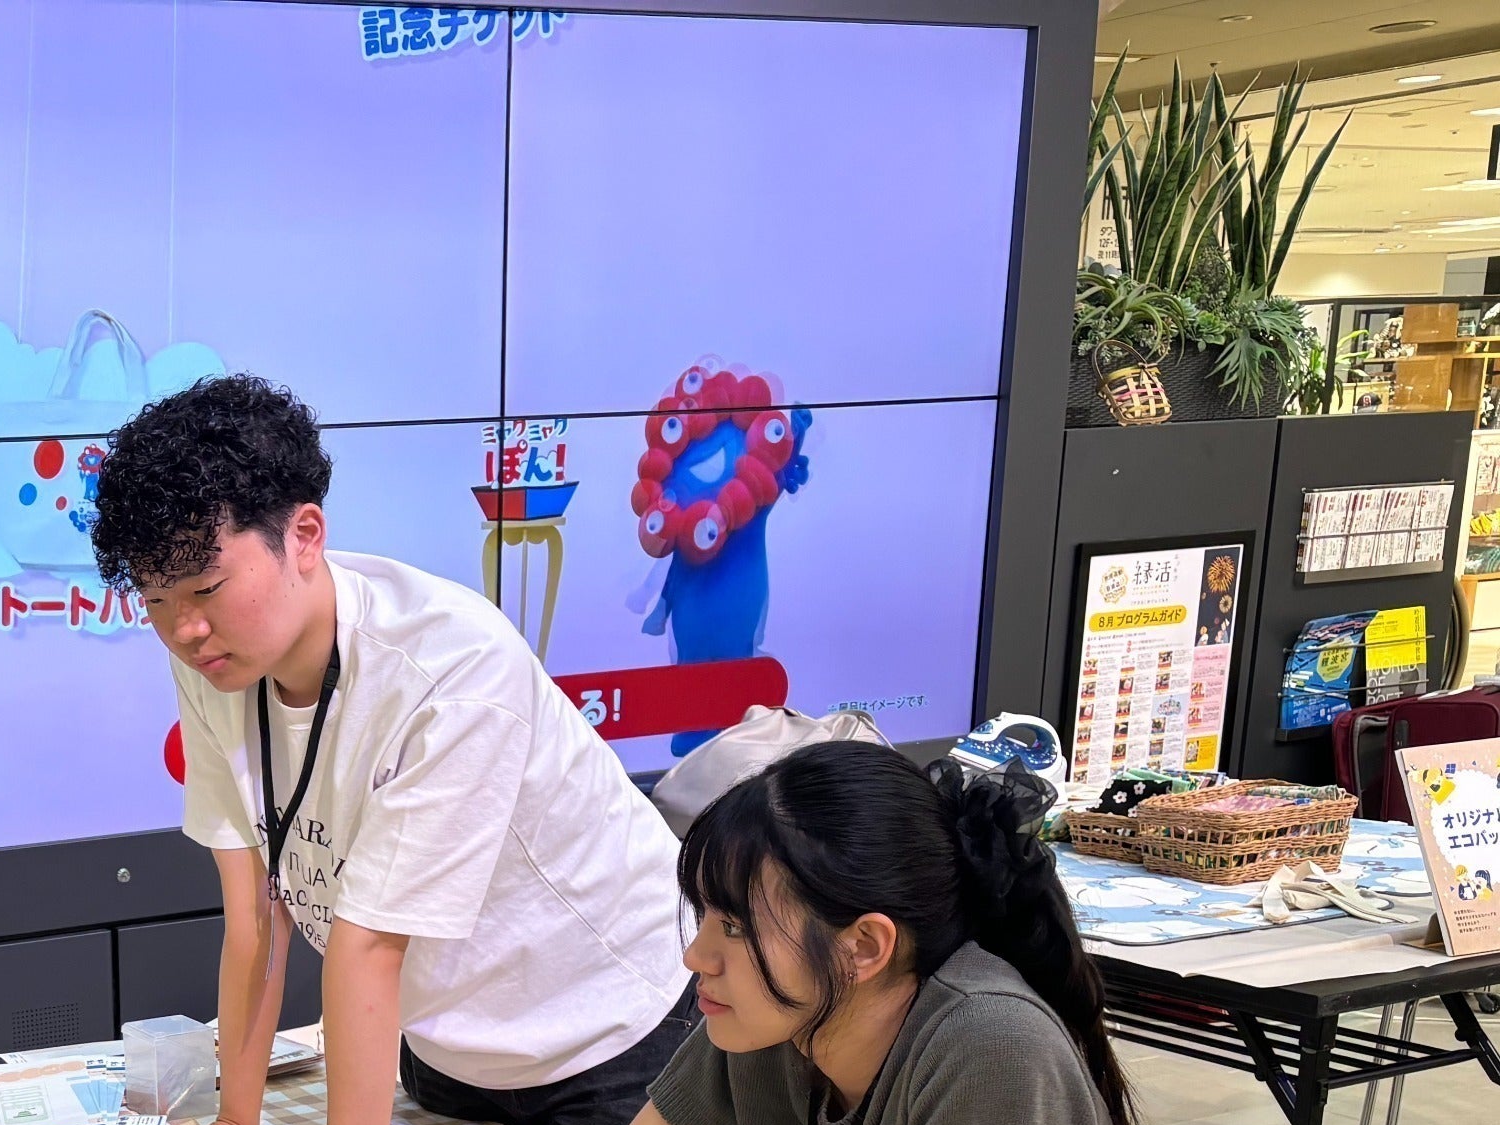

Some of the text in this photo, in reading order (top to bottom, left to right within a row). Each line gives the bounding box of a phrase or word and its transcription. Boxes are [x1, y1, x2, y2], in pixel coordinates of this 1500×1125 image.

[1132, 561, 1171, 585] 縁活
[1099, 608, 1182, 629] 8月 プログラムガイド
[1367, 677, 1387, 695] OF
[1442, 808, 1500, 829] オリジナ
